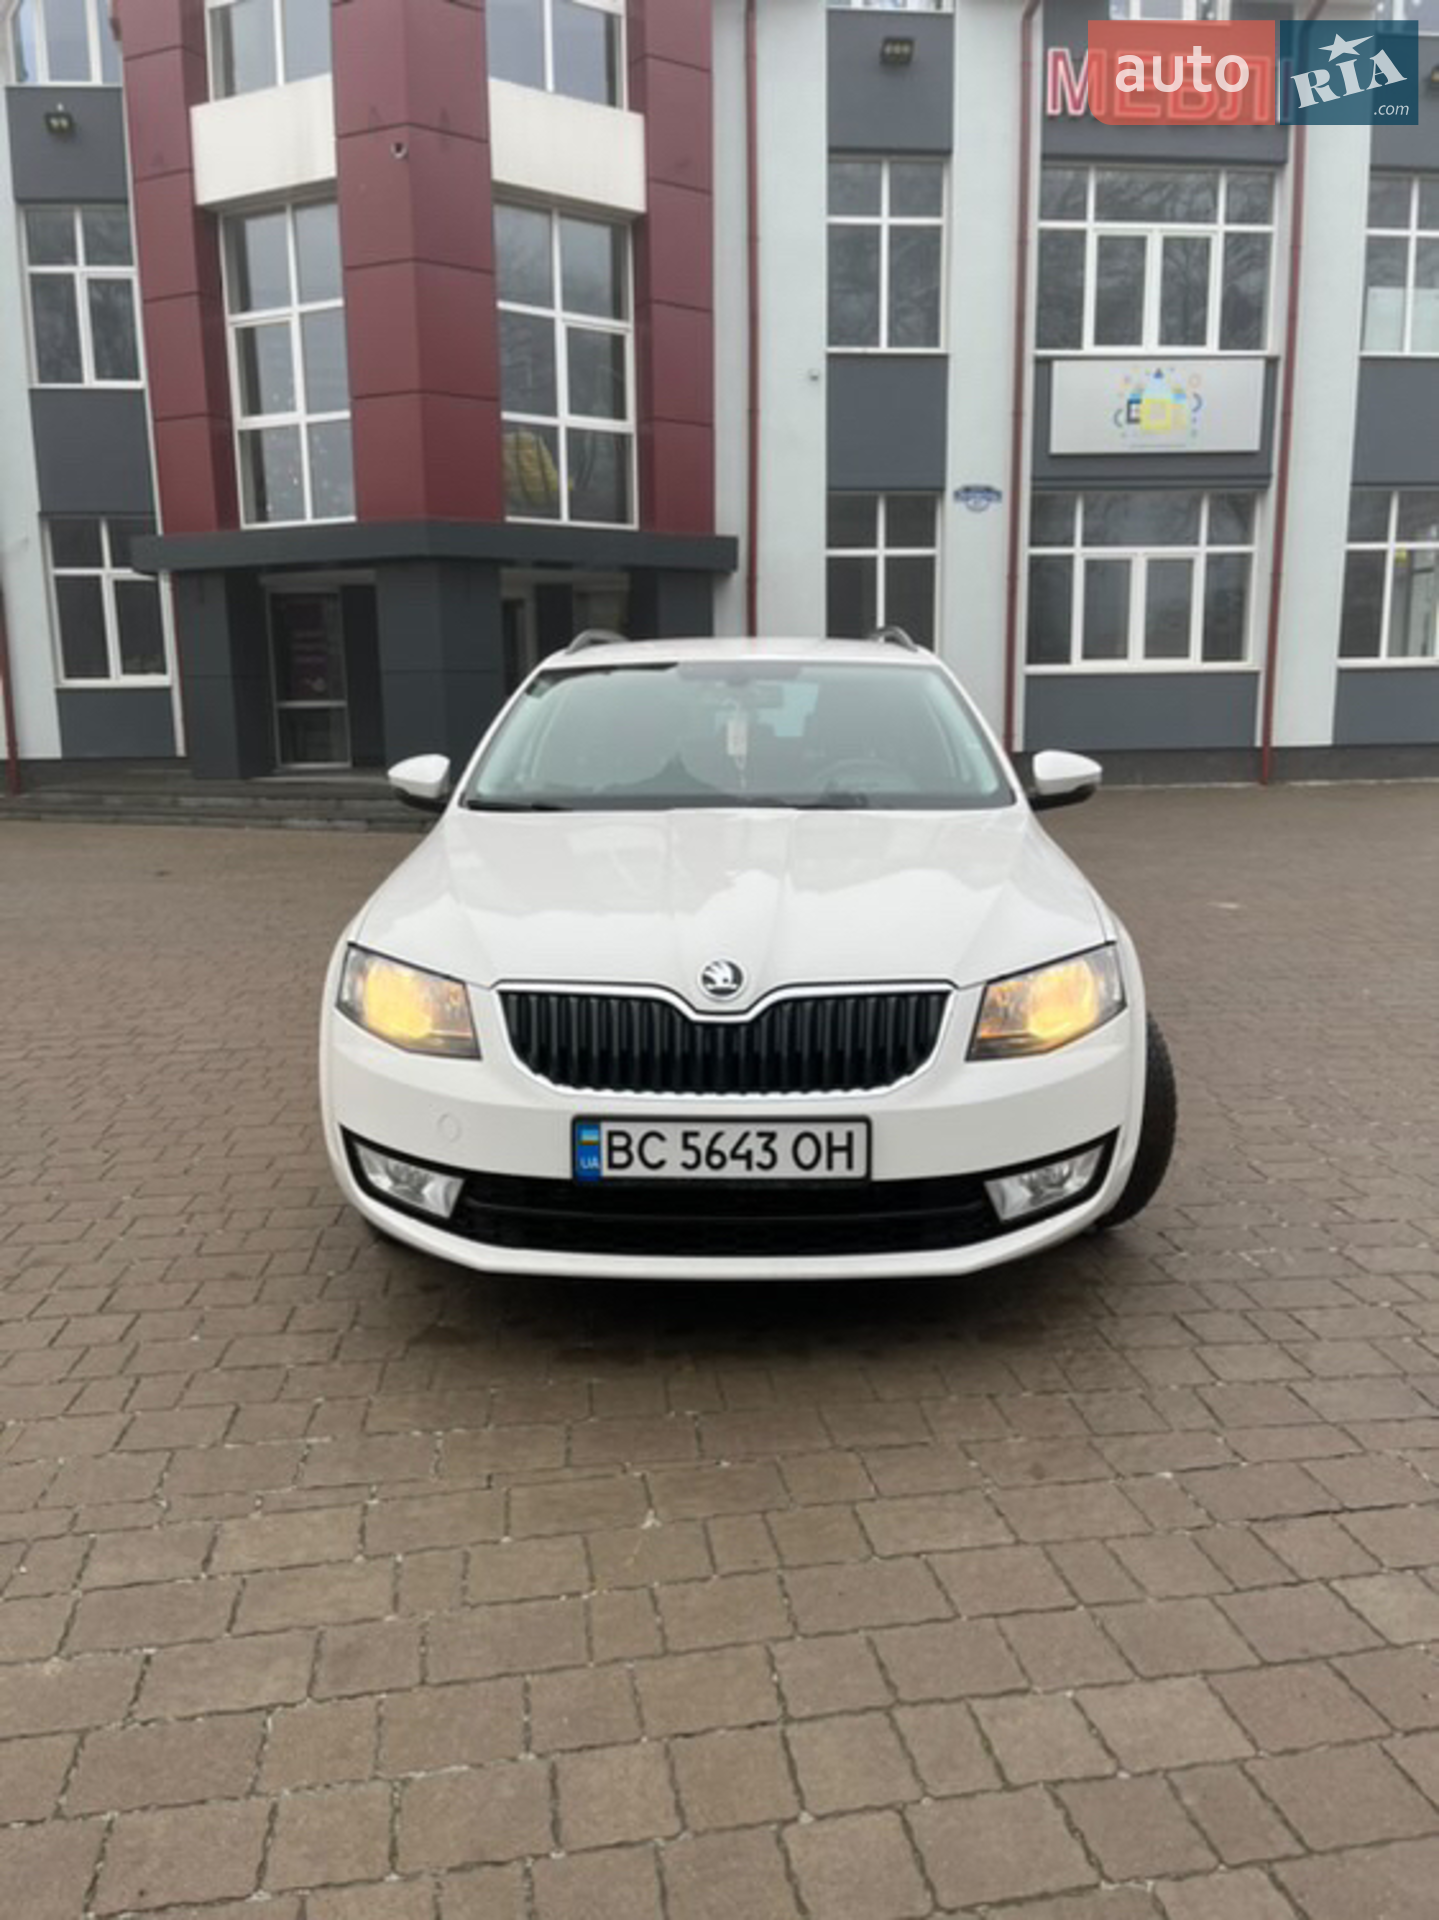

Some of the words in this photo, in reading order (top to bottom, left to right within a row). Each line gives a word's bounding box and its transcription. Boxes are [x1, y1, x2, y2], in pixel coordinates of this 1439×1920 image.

[607, 1130, 668, 1171] BC
[680, 1130, 778, 1171] 5643
[791, 1130, 855, 1171] OH
